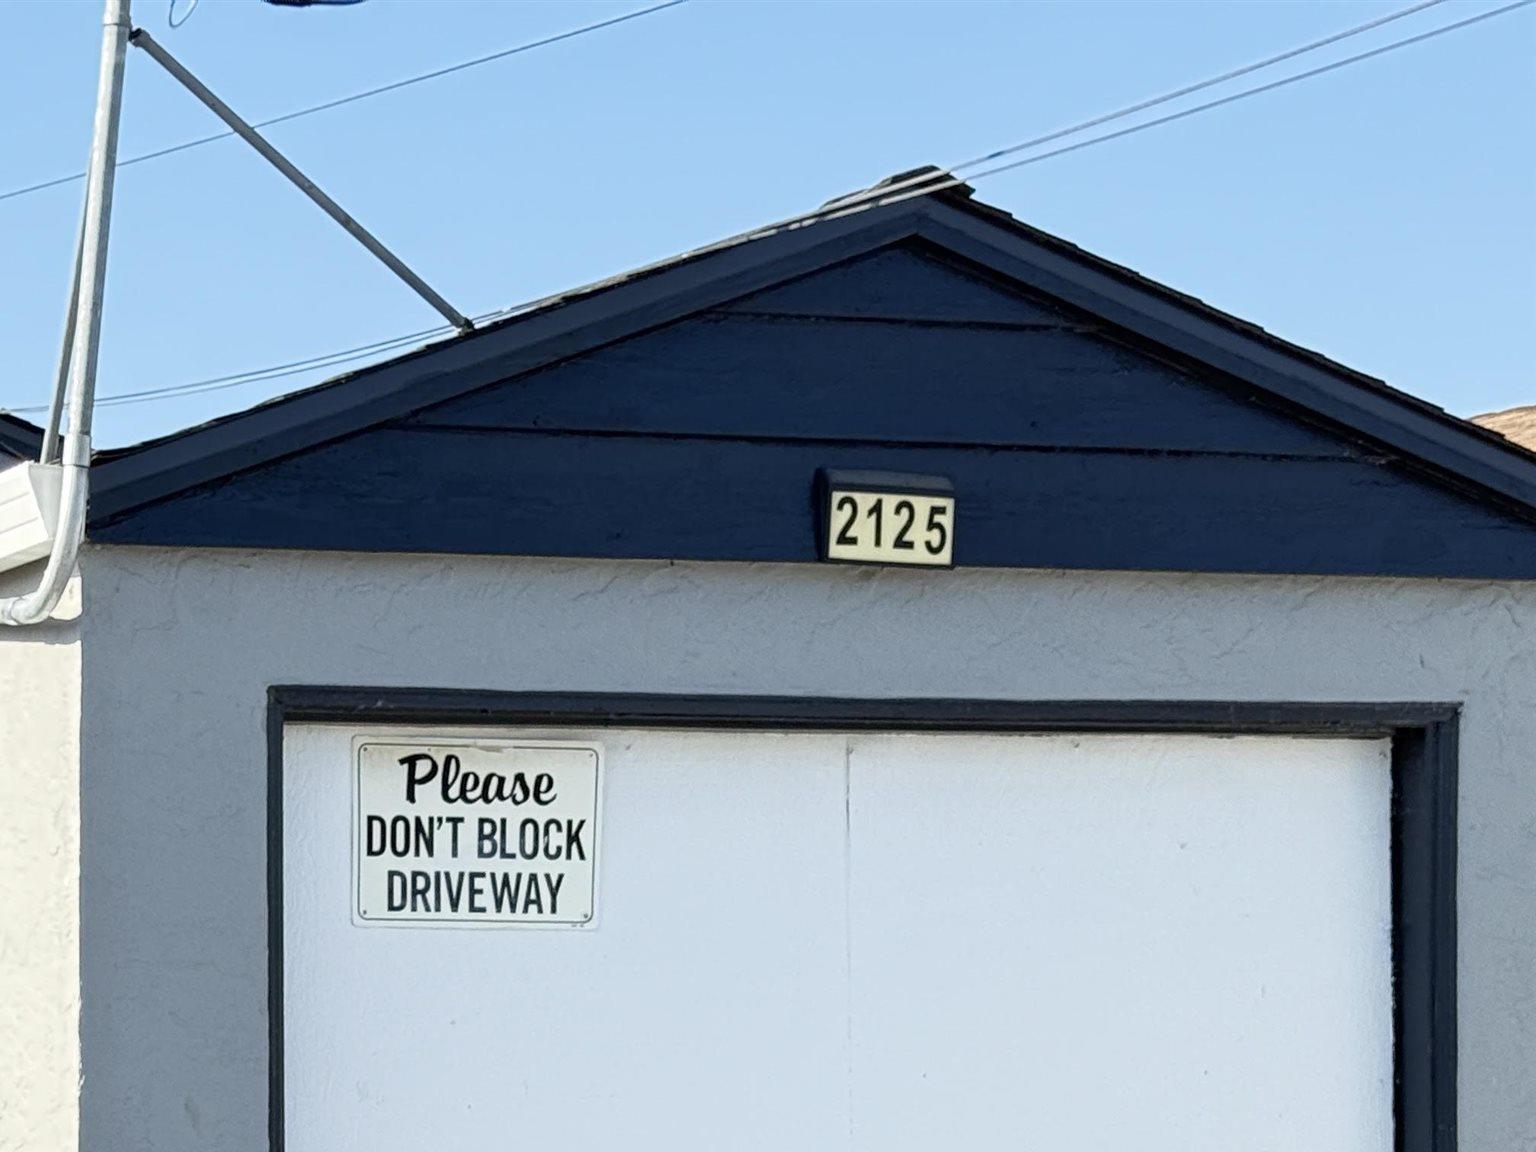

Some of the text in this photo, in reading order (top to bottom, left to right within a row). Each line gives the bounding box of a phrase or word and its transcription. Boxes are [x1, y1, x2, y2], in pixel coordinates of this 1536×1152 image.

[835, 496, 947, 556] 2125
[397, 753, 558, 806] Please
[366, 814, 587, 861] DON'T BLOCK
[386, 870, 565, 915] DRIVEWAY
